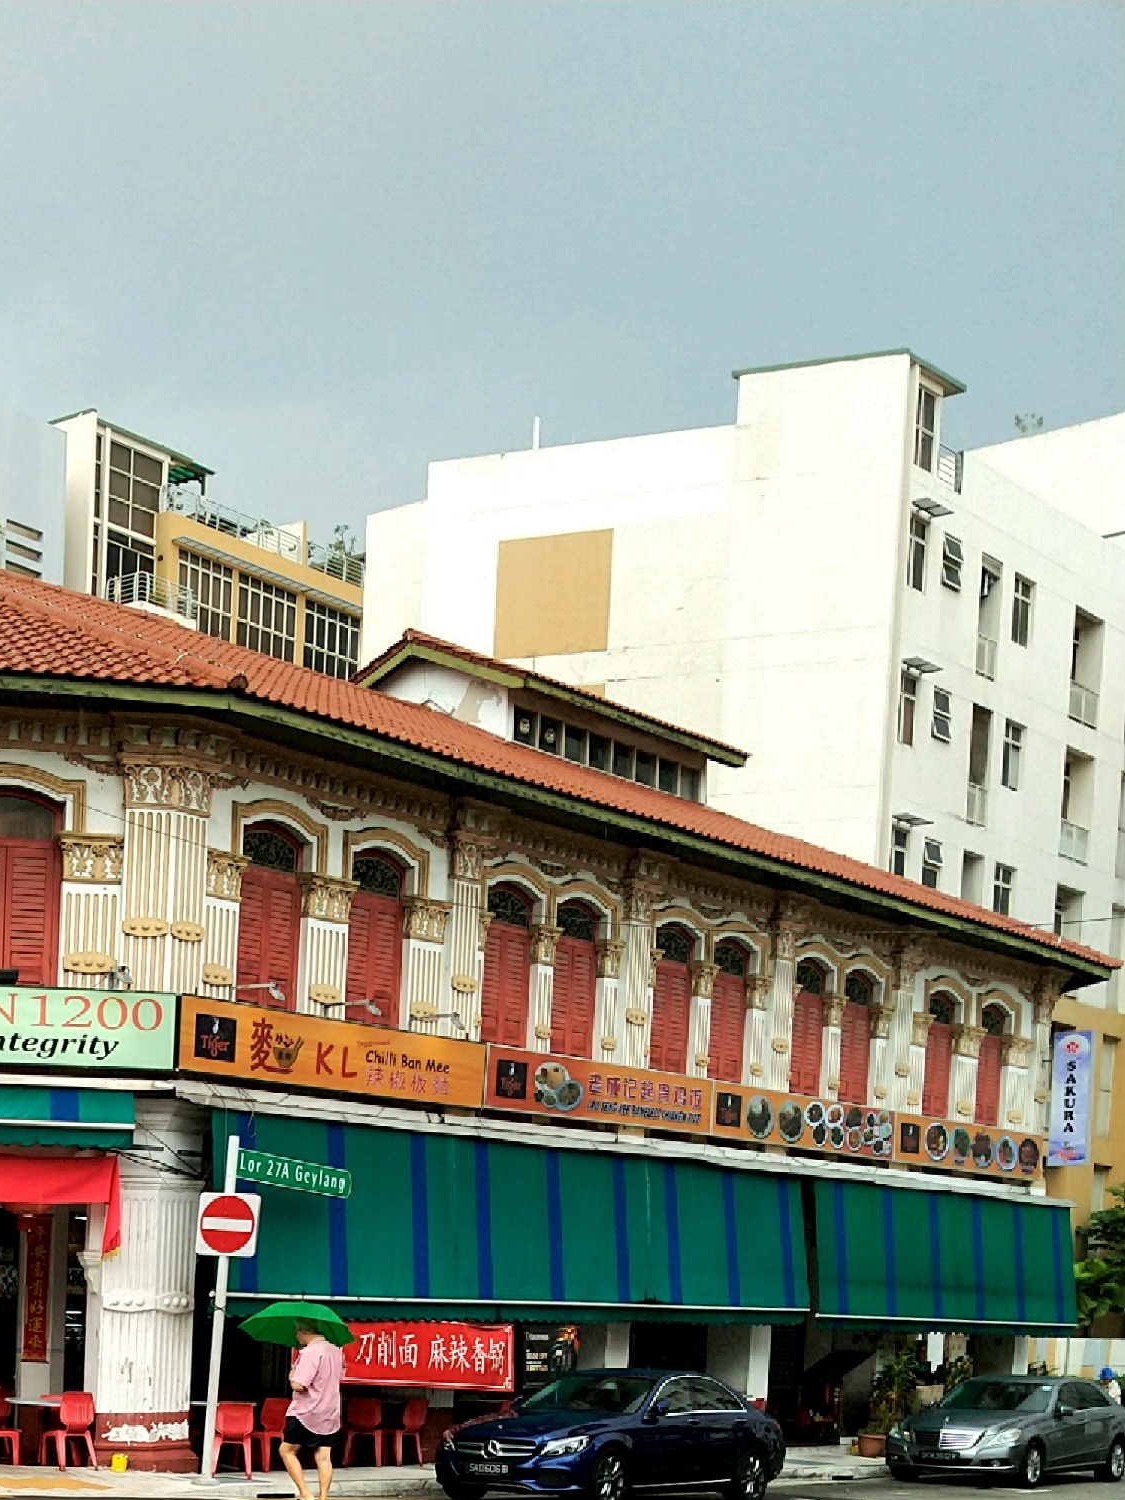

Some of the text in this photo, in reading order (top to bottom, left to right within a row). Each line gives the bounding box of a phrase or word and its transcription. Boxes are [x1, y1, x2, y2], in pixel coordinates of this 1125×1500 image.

[30, 994, 163, 1031] 1200
[200, 1034, 230, 1057] Tiger
[366, 1050, 450, 1074] Chilli Ban Mee
[1063, 1060, 1076, 1132] SAKURA
[240, 1153, 346, 1193] Lor 27A Geylang
[355, 1330, 418, 1369] 刀削面
